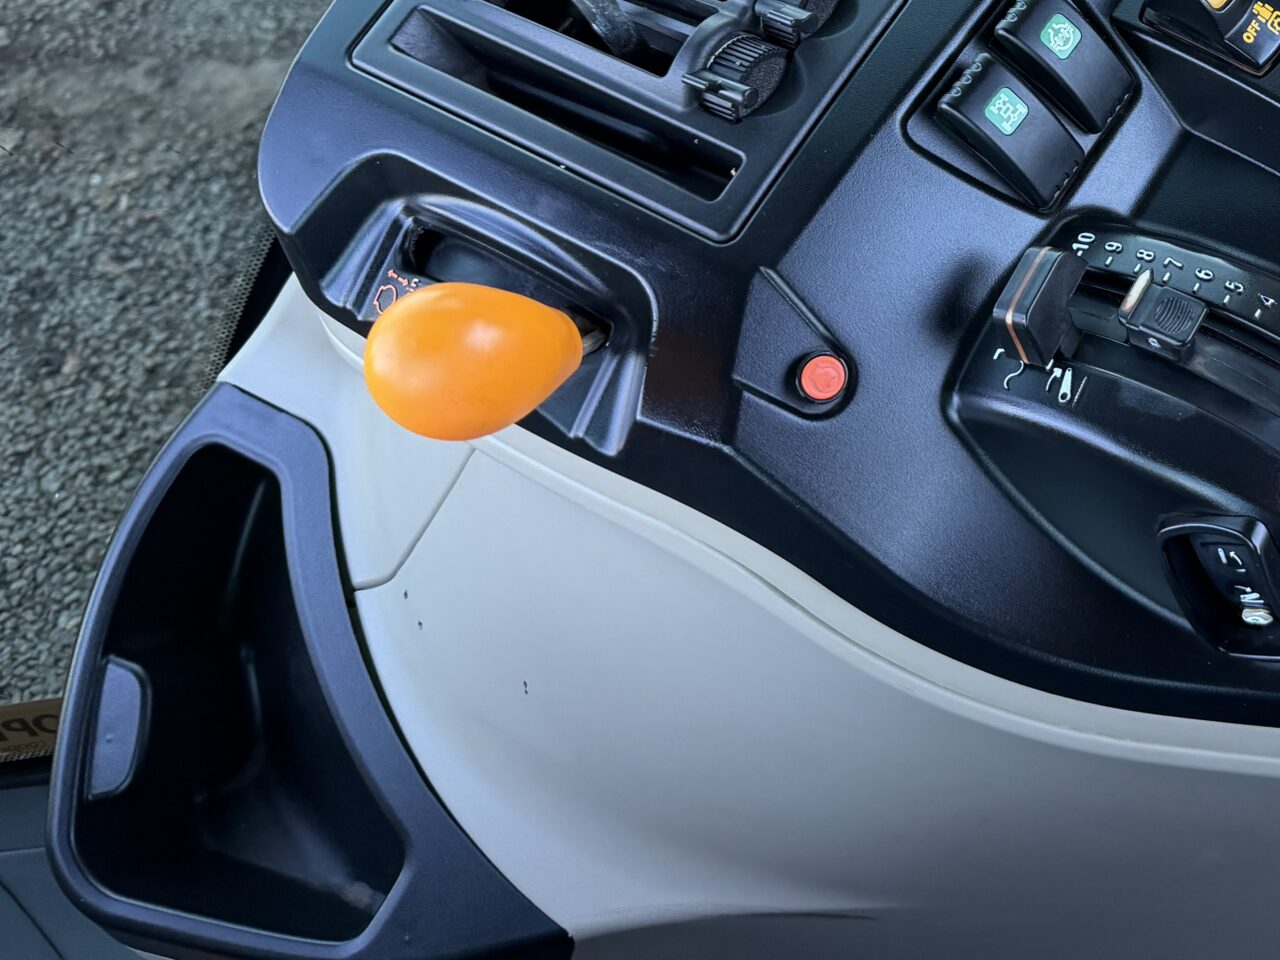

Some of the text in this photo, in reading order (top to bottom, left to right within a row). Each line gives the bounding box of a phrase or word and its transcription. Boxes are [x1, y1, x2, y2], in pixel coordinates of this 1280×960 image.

[1242, 20, 1261, 44] OFF
[1072, 232, 1095, 251] 10
[1105, 242, 1122, 254] 9
[1136, 249, 1155, 262] 8
[1163, 257, 1183, 269] 7
[1195, 268, 1214, 280] 6
[1225, 280, 1244, 294] 5
[1258, 293, 1277, 309] 4
